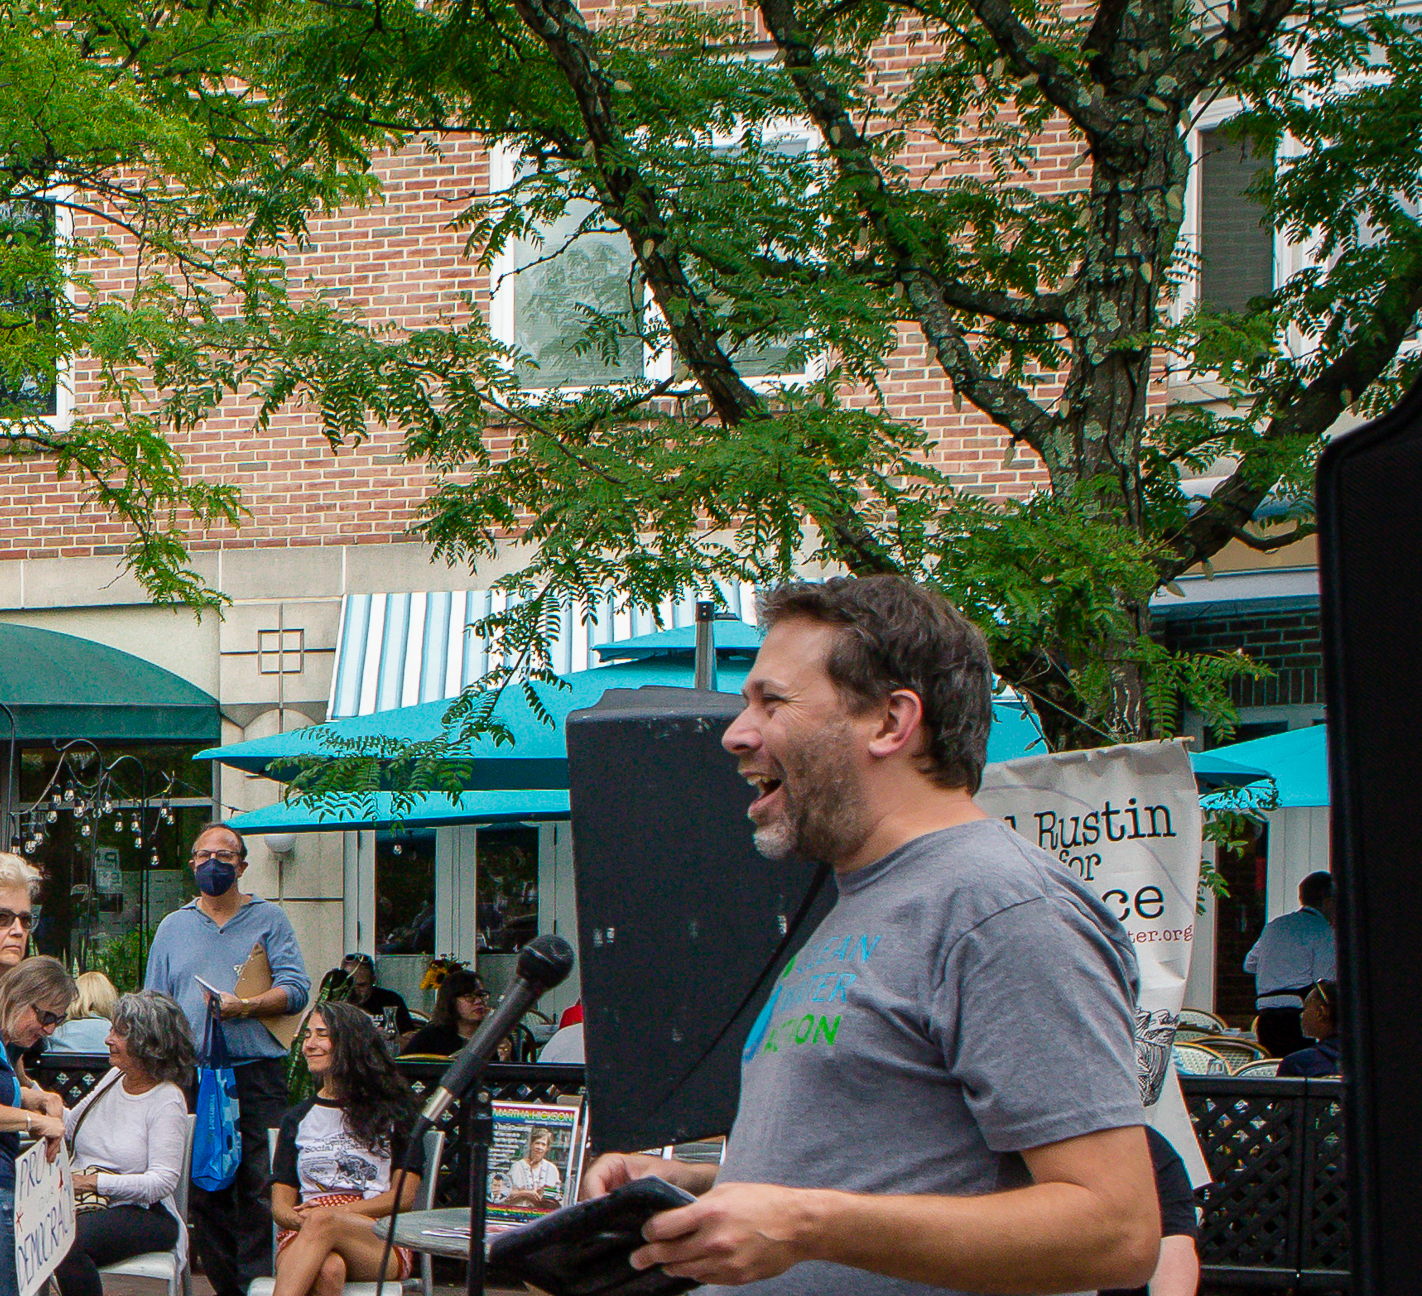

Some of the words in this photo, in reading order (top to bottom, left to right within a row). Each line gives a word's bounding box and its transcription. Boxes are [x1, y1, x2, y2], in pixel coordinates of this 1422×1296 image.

[1033, 797, 1177, 851] Rustin
[493, 1108, 530, 1119] MARTHA
[531, 1110, 573, 1122] HICKSON
